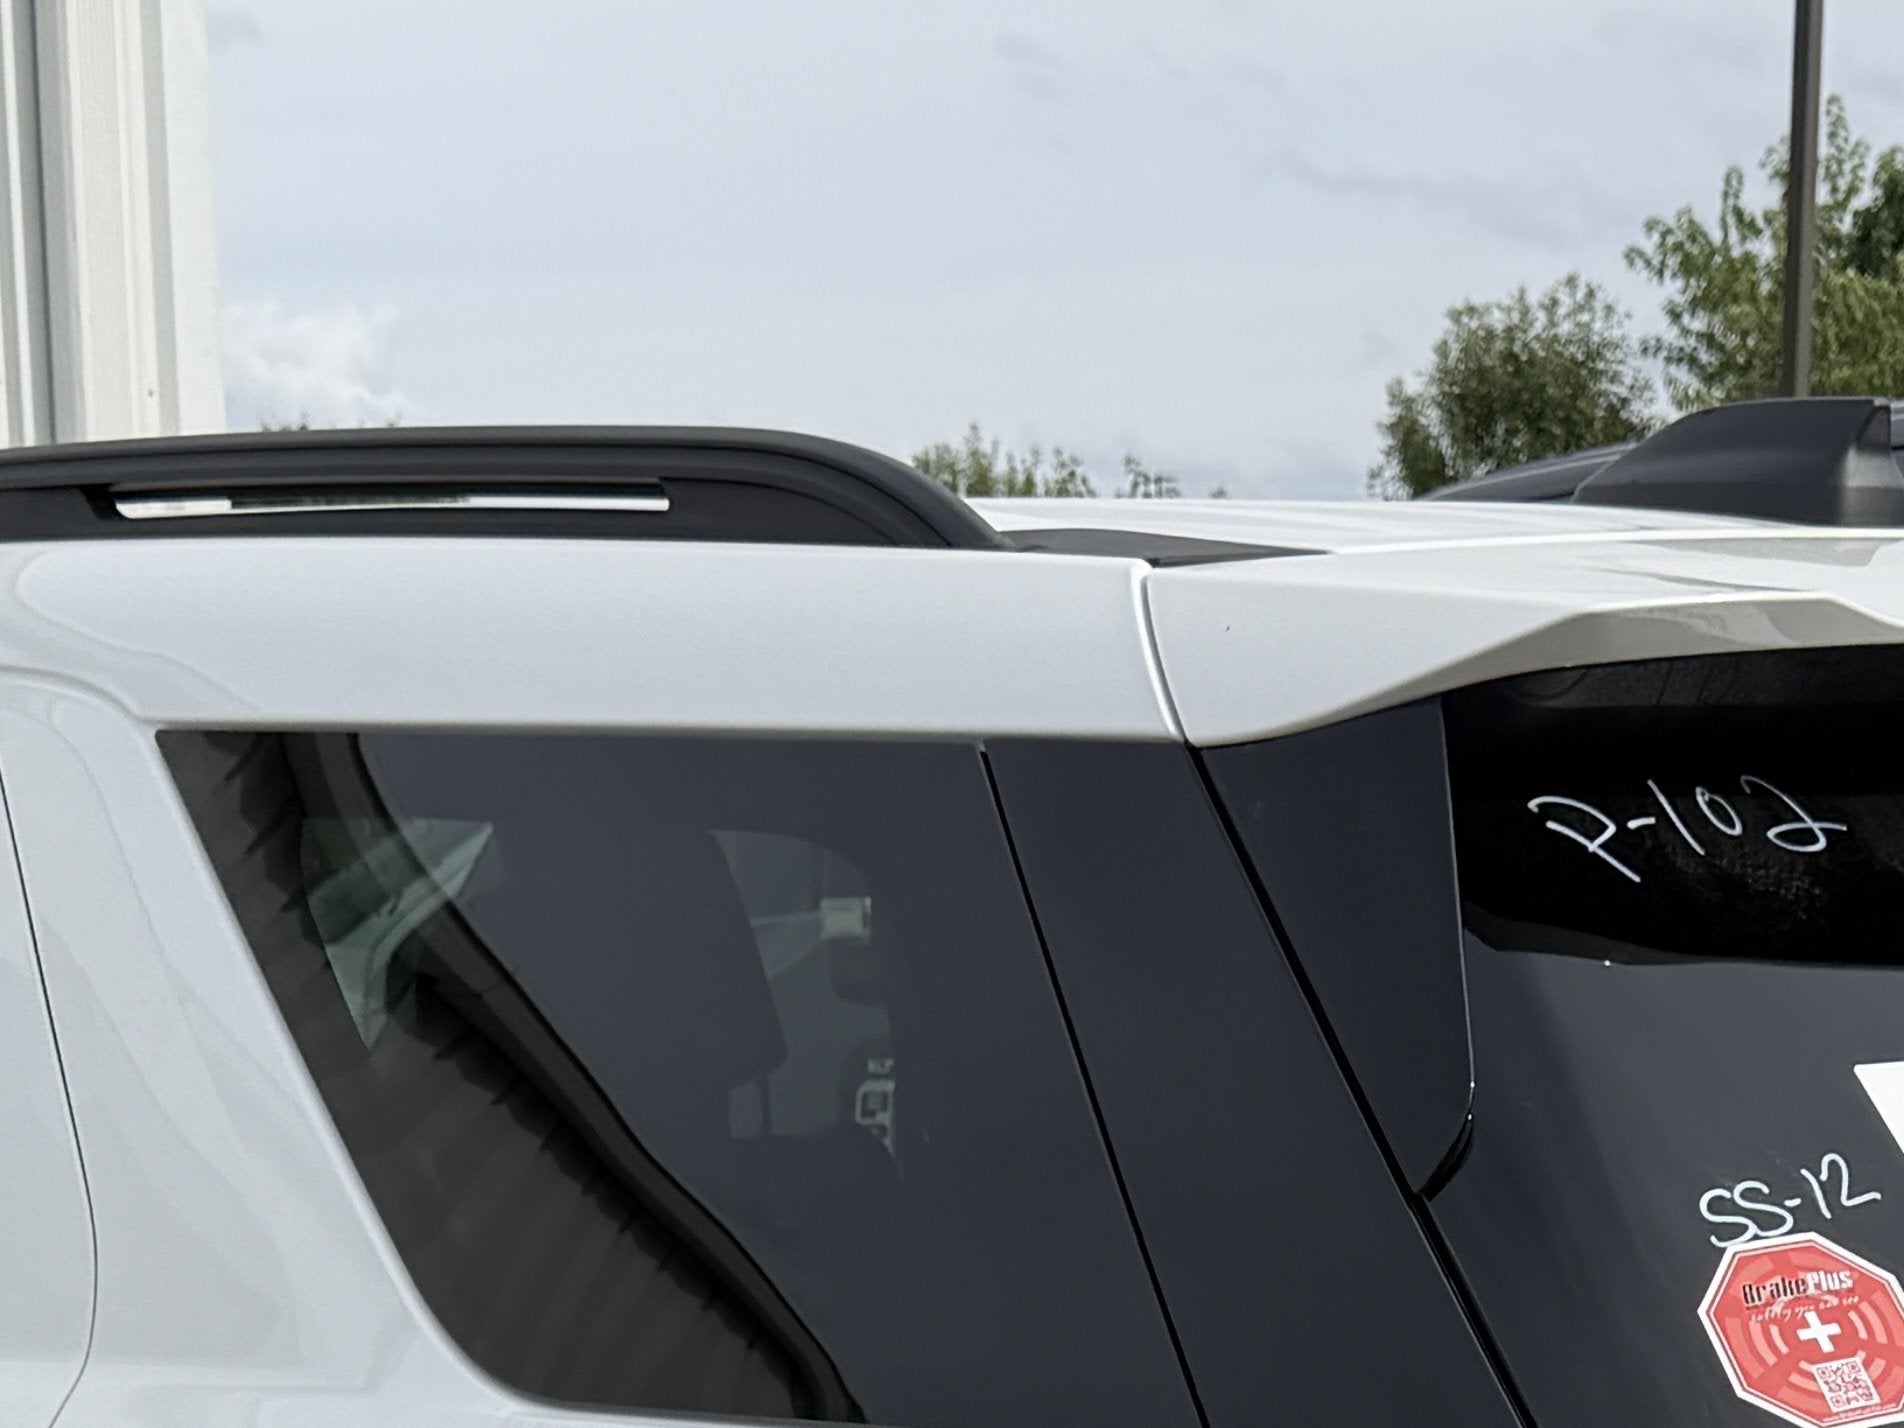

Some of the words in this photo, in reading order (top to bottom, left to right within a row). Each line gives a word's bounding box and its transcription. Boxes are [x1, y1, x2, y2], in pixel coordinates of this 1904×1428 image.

[1527, 774, 1849, 884] P-102
[1698, 1152, 1883, 1248] SS-12
[1742, 1269, 1855, 1306] BrakePlus
